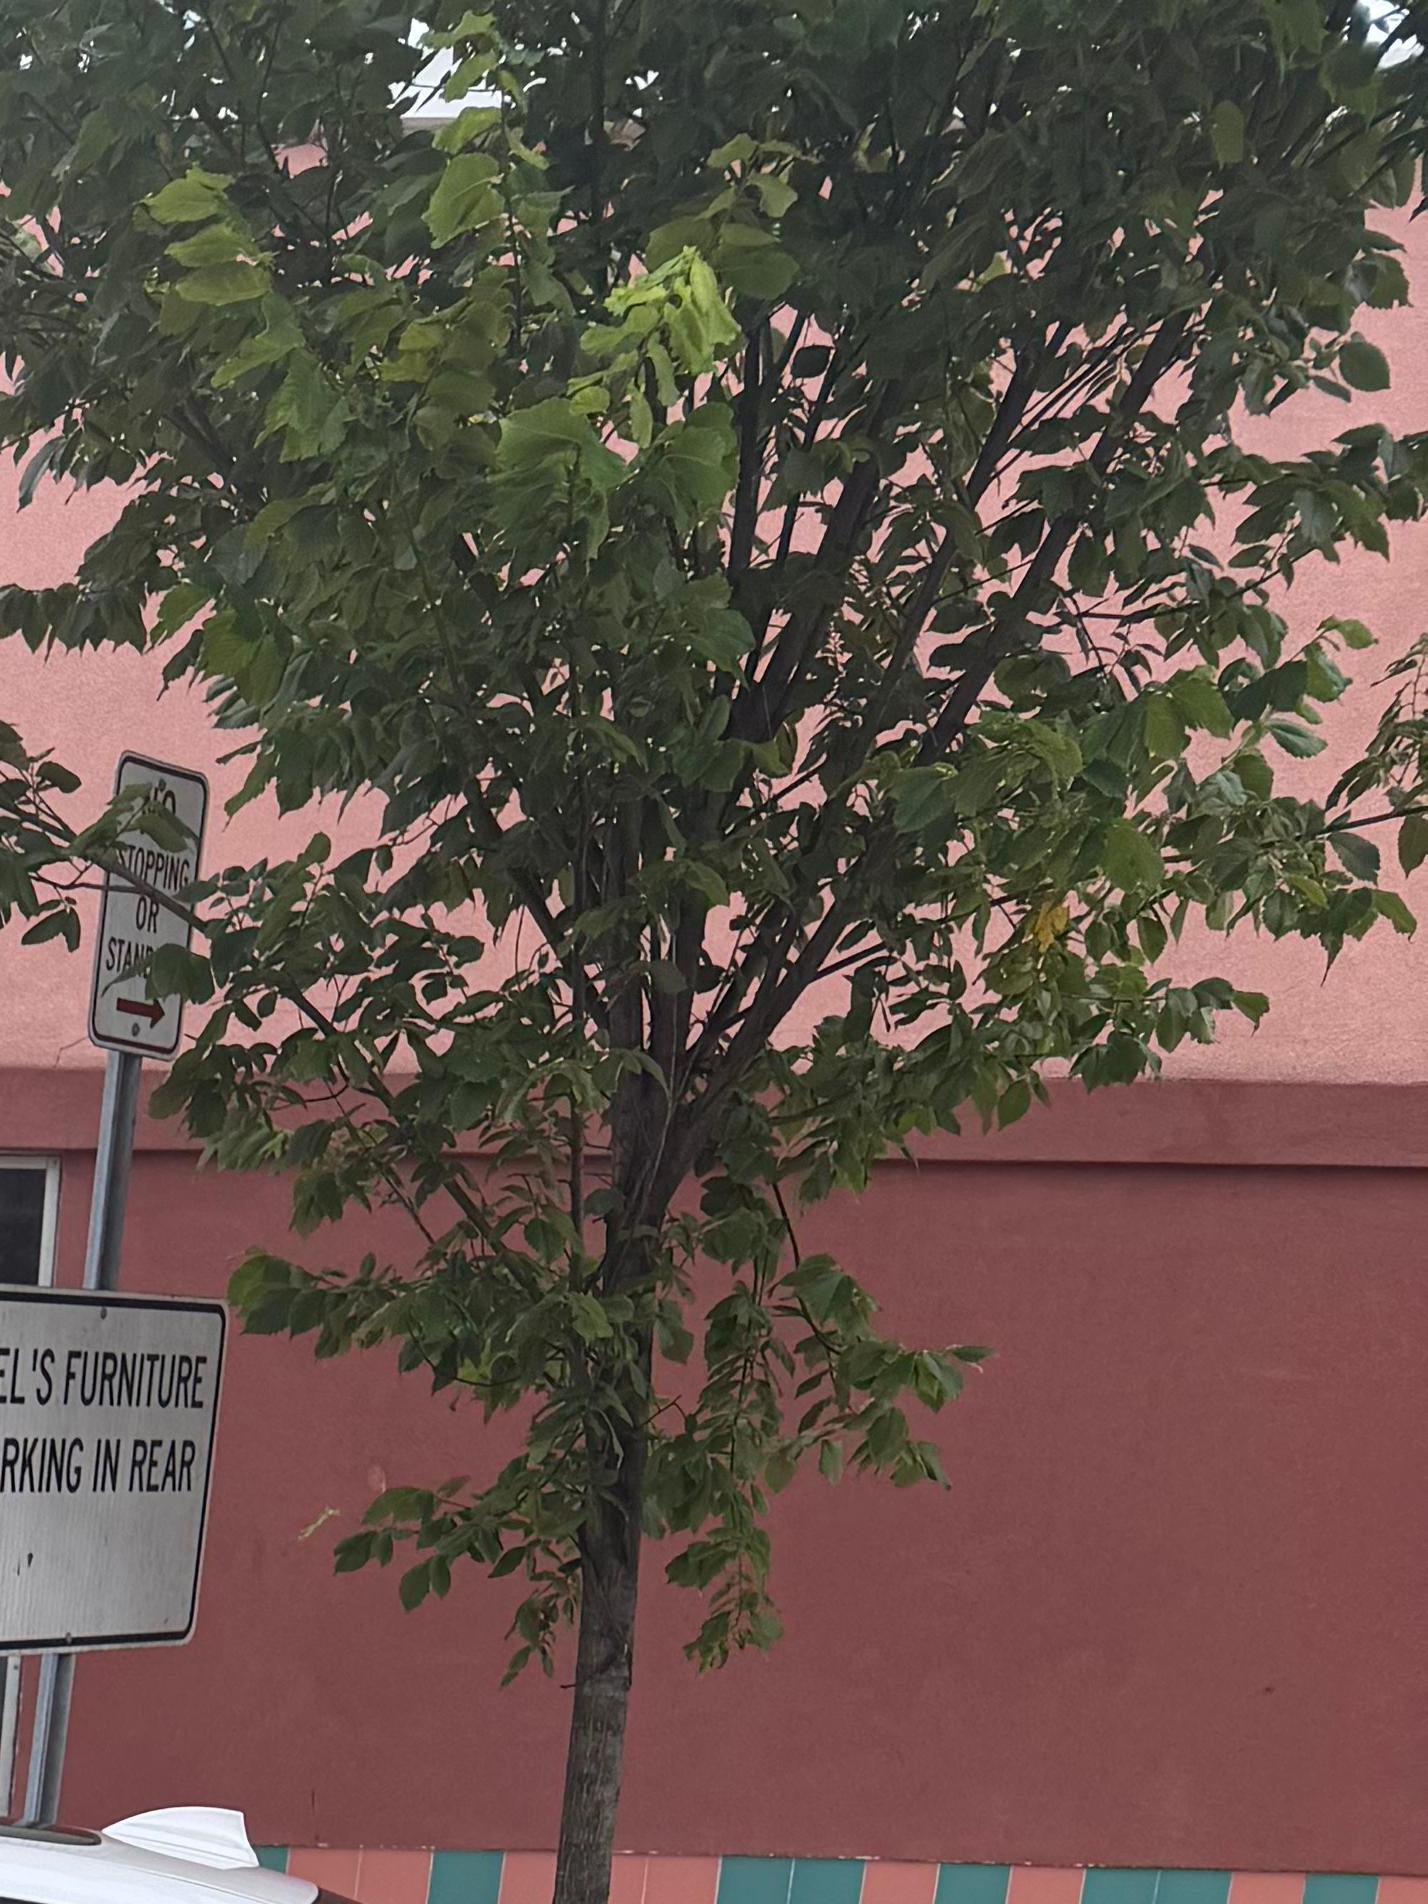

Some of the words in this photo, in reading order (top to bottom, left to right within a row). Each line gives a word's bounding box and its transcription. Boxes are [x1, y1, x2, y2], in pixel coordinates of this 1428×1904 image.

[135, 895, 160, 934] OR
[63, 1350, 208, 1409] FURNITURE
[92, 1438, 121, 1492] IN
[128, 1439, 197, 1492] REAR
